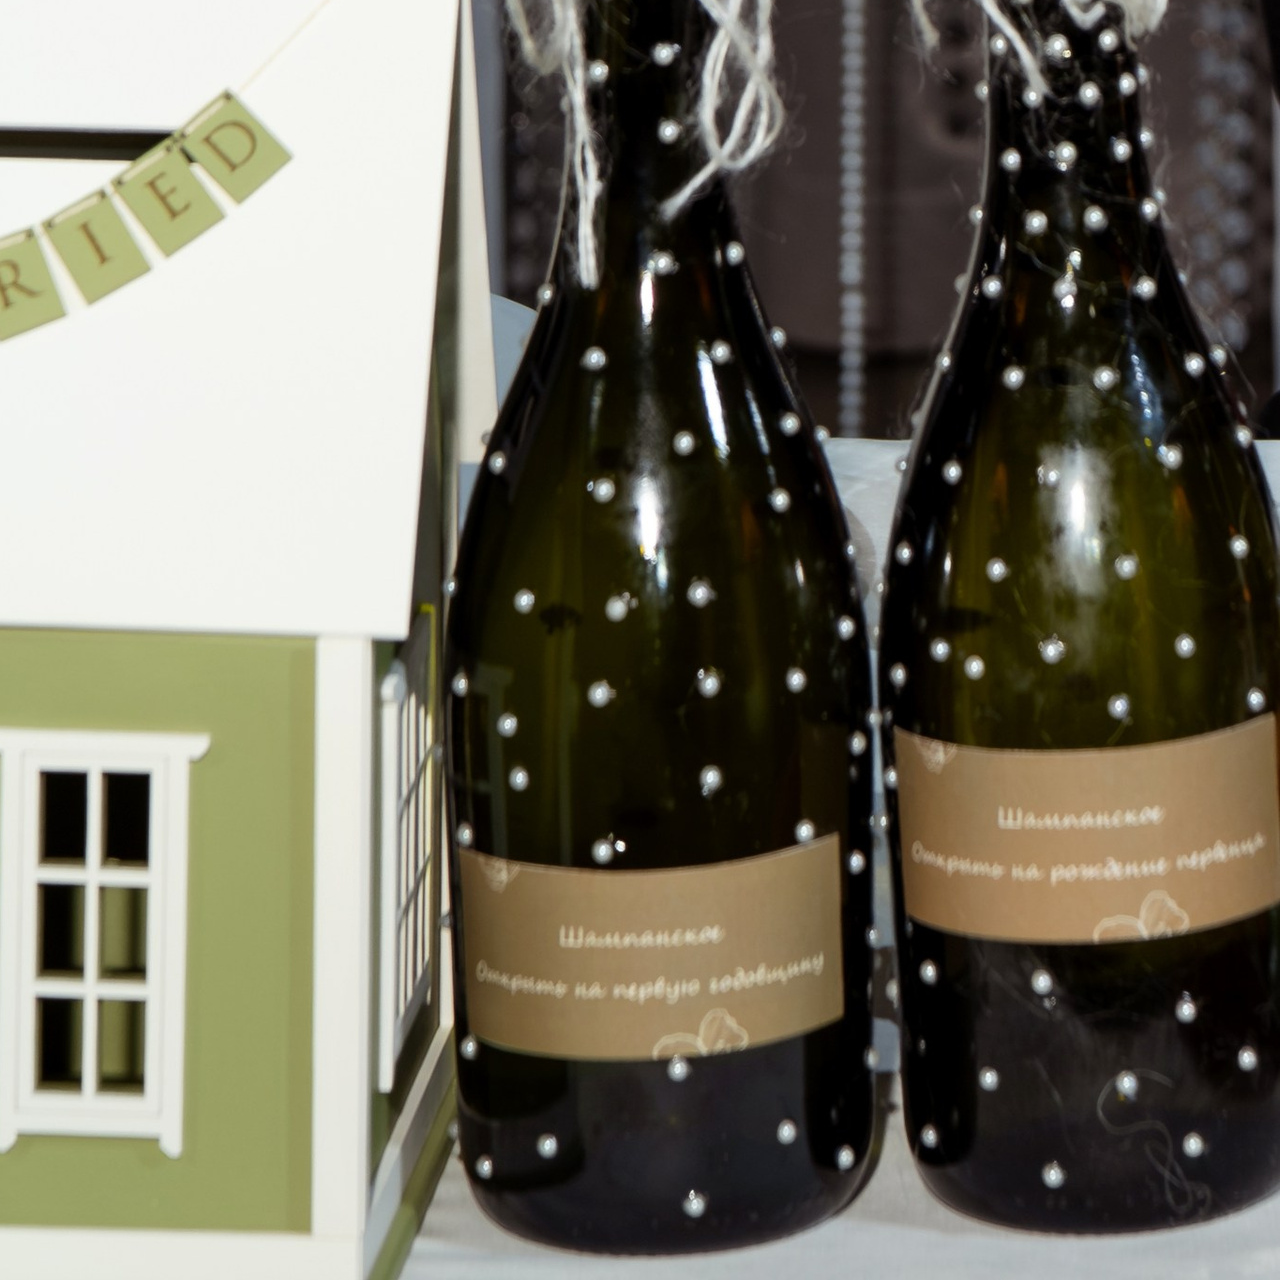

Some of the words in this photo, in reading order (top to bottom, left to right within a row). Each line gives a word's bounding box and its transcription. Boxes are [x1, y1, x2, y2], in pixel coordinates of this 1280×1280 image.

[996, 803, 1166, 831] Шампанское
[910, 839, 1005, 881] Открыть
[1010, 861, 1043, 883] на
[1049, 855, 1170, 888] рождение
[558, 923, 727, 950] Шампанское
[475, 958, 568, 1000] Открыть
[573, 980, 607, 1001] на
[612, 974, 701, 1006] первую
[708, 950, 825, 996] годовщину
